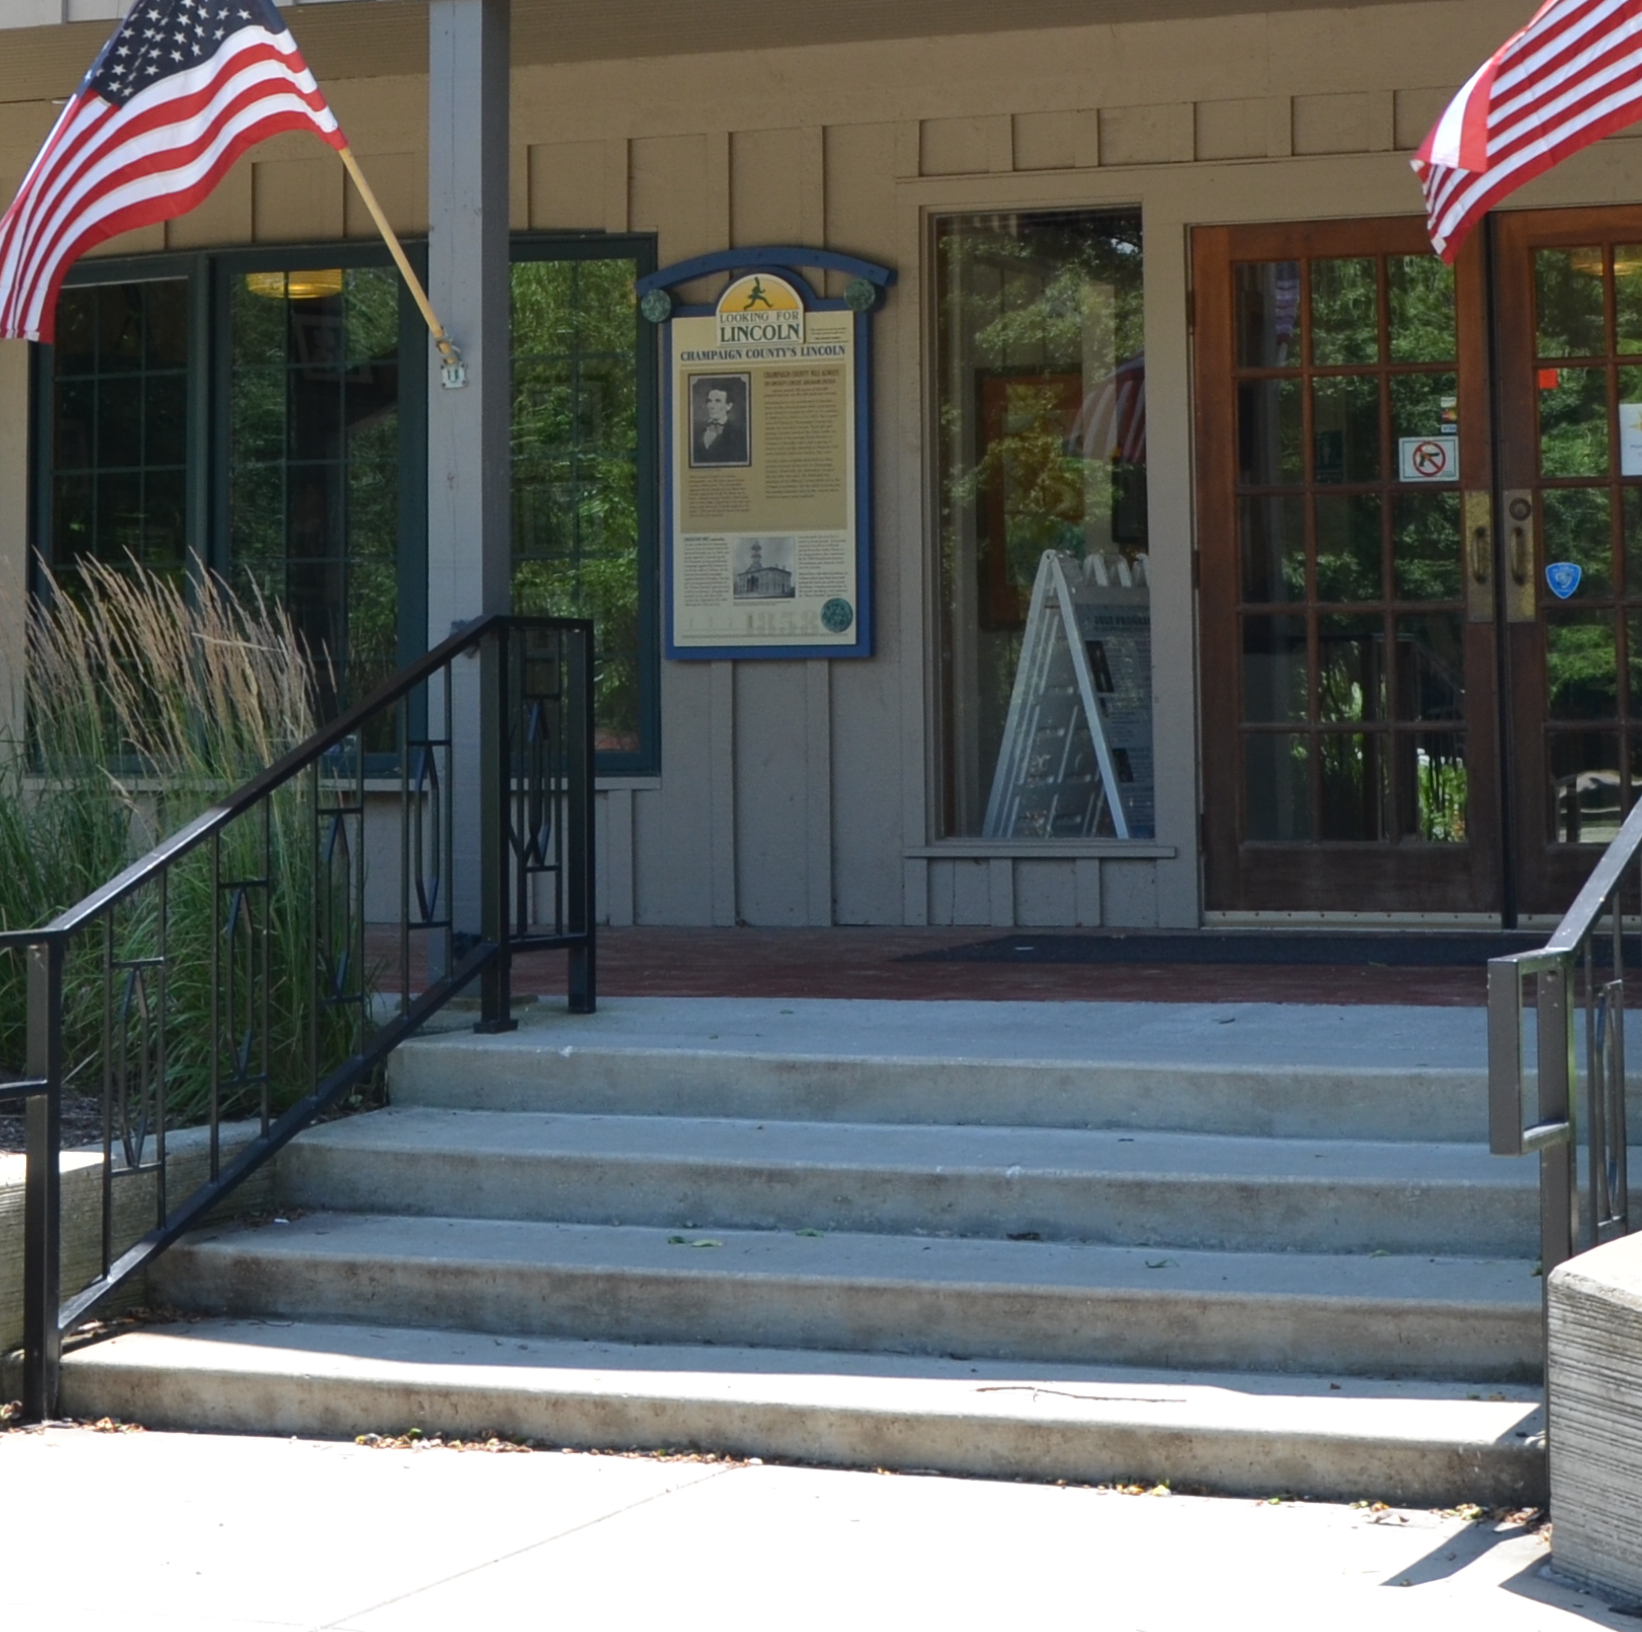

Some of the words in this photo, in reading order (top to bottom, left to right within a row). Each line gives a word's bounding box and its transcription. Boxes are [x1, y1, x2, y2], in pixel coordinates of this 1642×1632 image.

[719, 311, 770, 324] LOOKING
[775, 310, 800, 322] FOR
[719, 323, 801, 343] LINCOLN
[680, 349, 743, 362] CHAMPAIGN
[745, 346, 797, 360] COUNTY'S
[800, 344, 846, 357] LINCOLN
